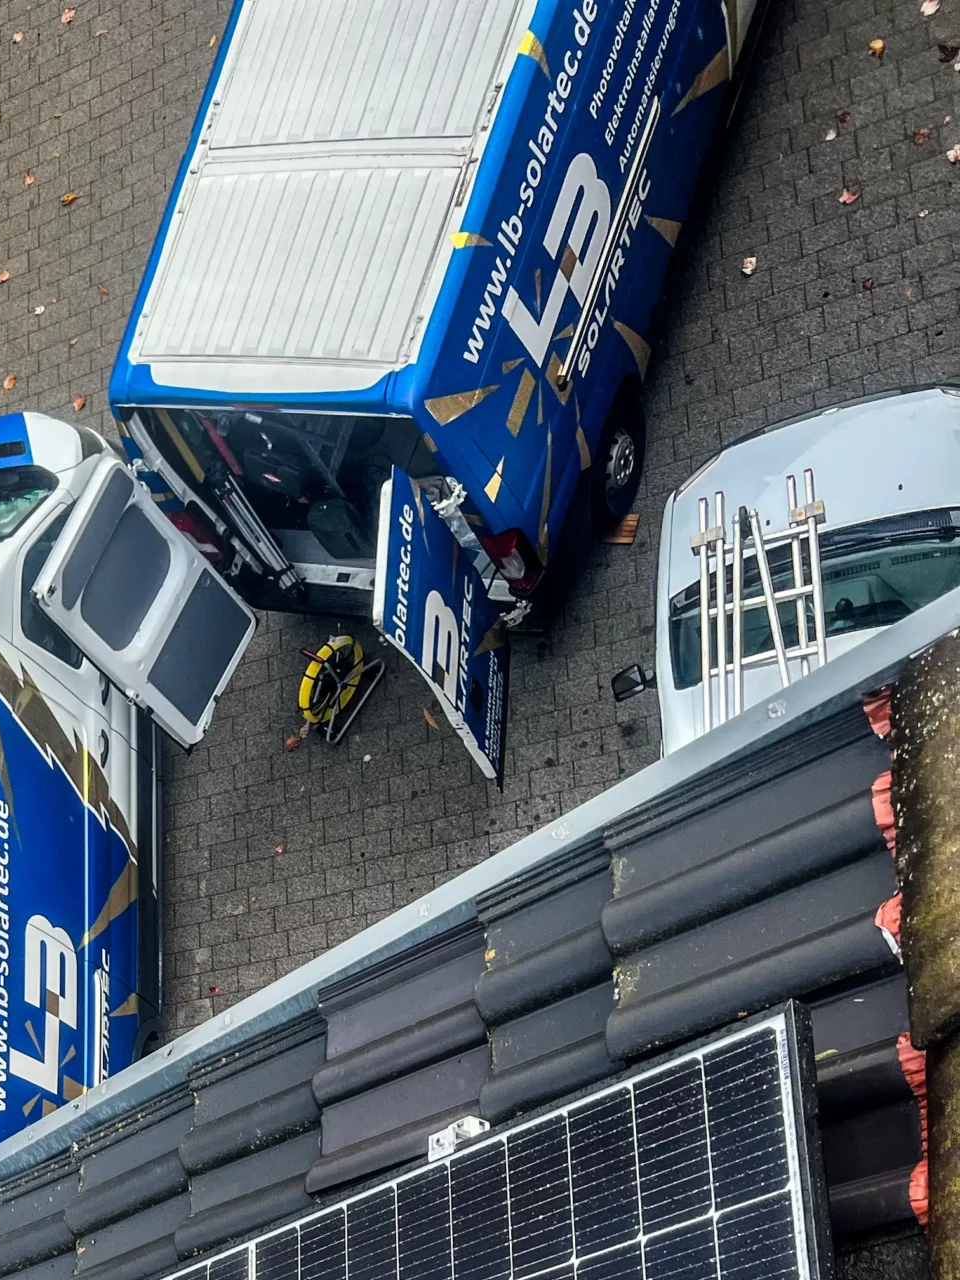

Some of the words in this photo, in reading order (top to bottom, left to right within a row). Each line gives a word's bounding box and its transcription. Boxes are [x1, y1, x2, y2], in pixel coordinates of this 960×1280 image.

[462, 0, 598, 365] www.lb-solartec.de
[501, 152, 612, 369] LB
[578, 168, 652, 379] SOLARTEC
[9, 914, 78, 1096] LB
[101, 948, 111, 1083] LARTEC
